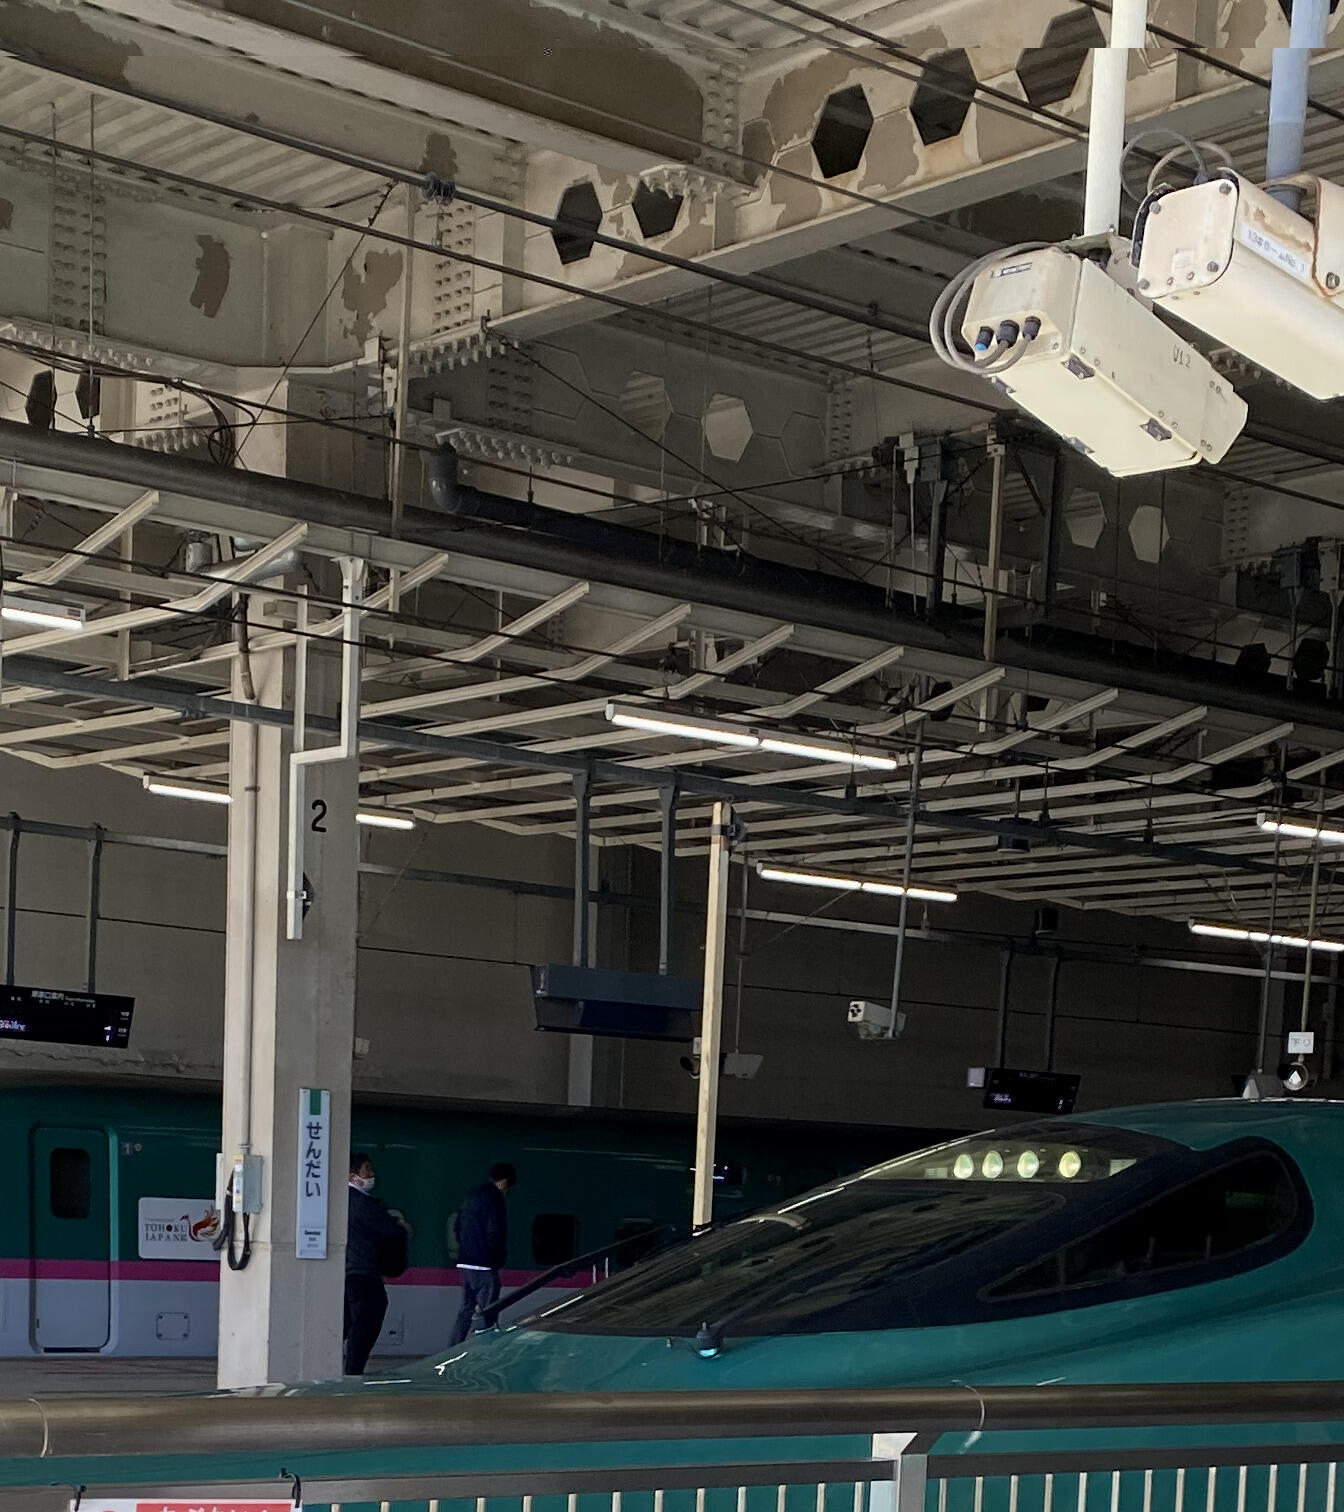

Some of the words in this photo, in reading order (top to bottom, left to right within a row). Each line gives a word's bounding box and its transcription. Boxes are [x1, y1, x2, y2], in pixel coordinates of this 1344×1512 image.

[311, 799, 327, 833] 2
[305, 1121, 323, 1198] せんだい
[144, 1223, 188, 1233] TOHOKU
